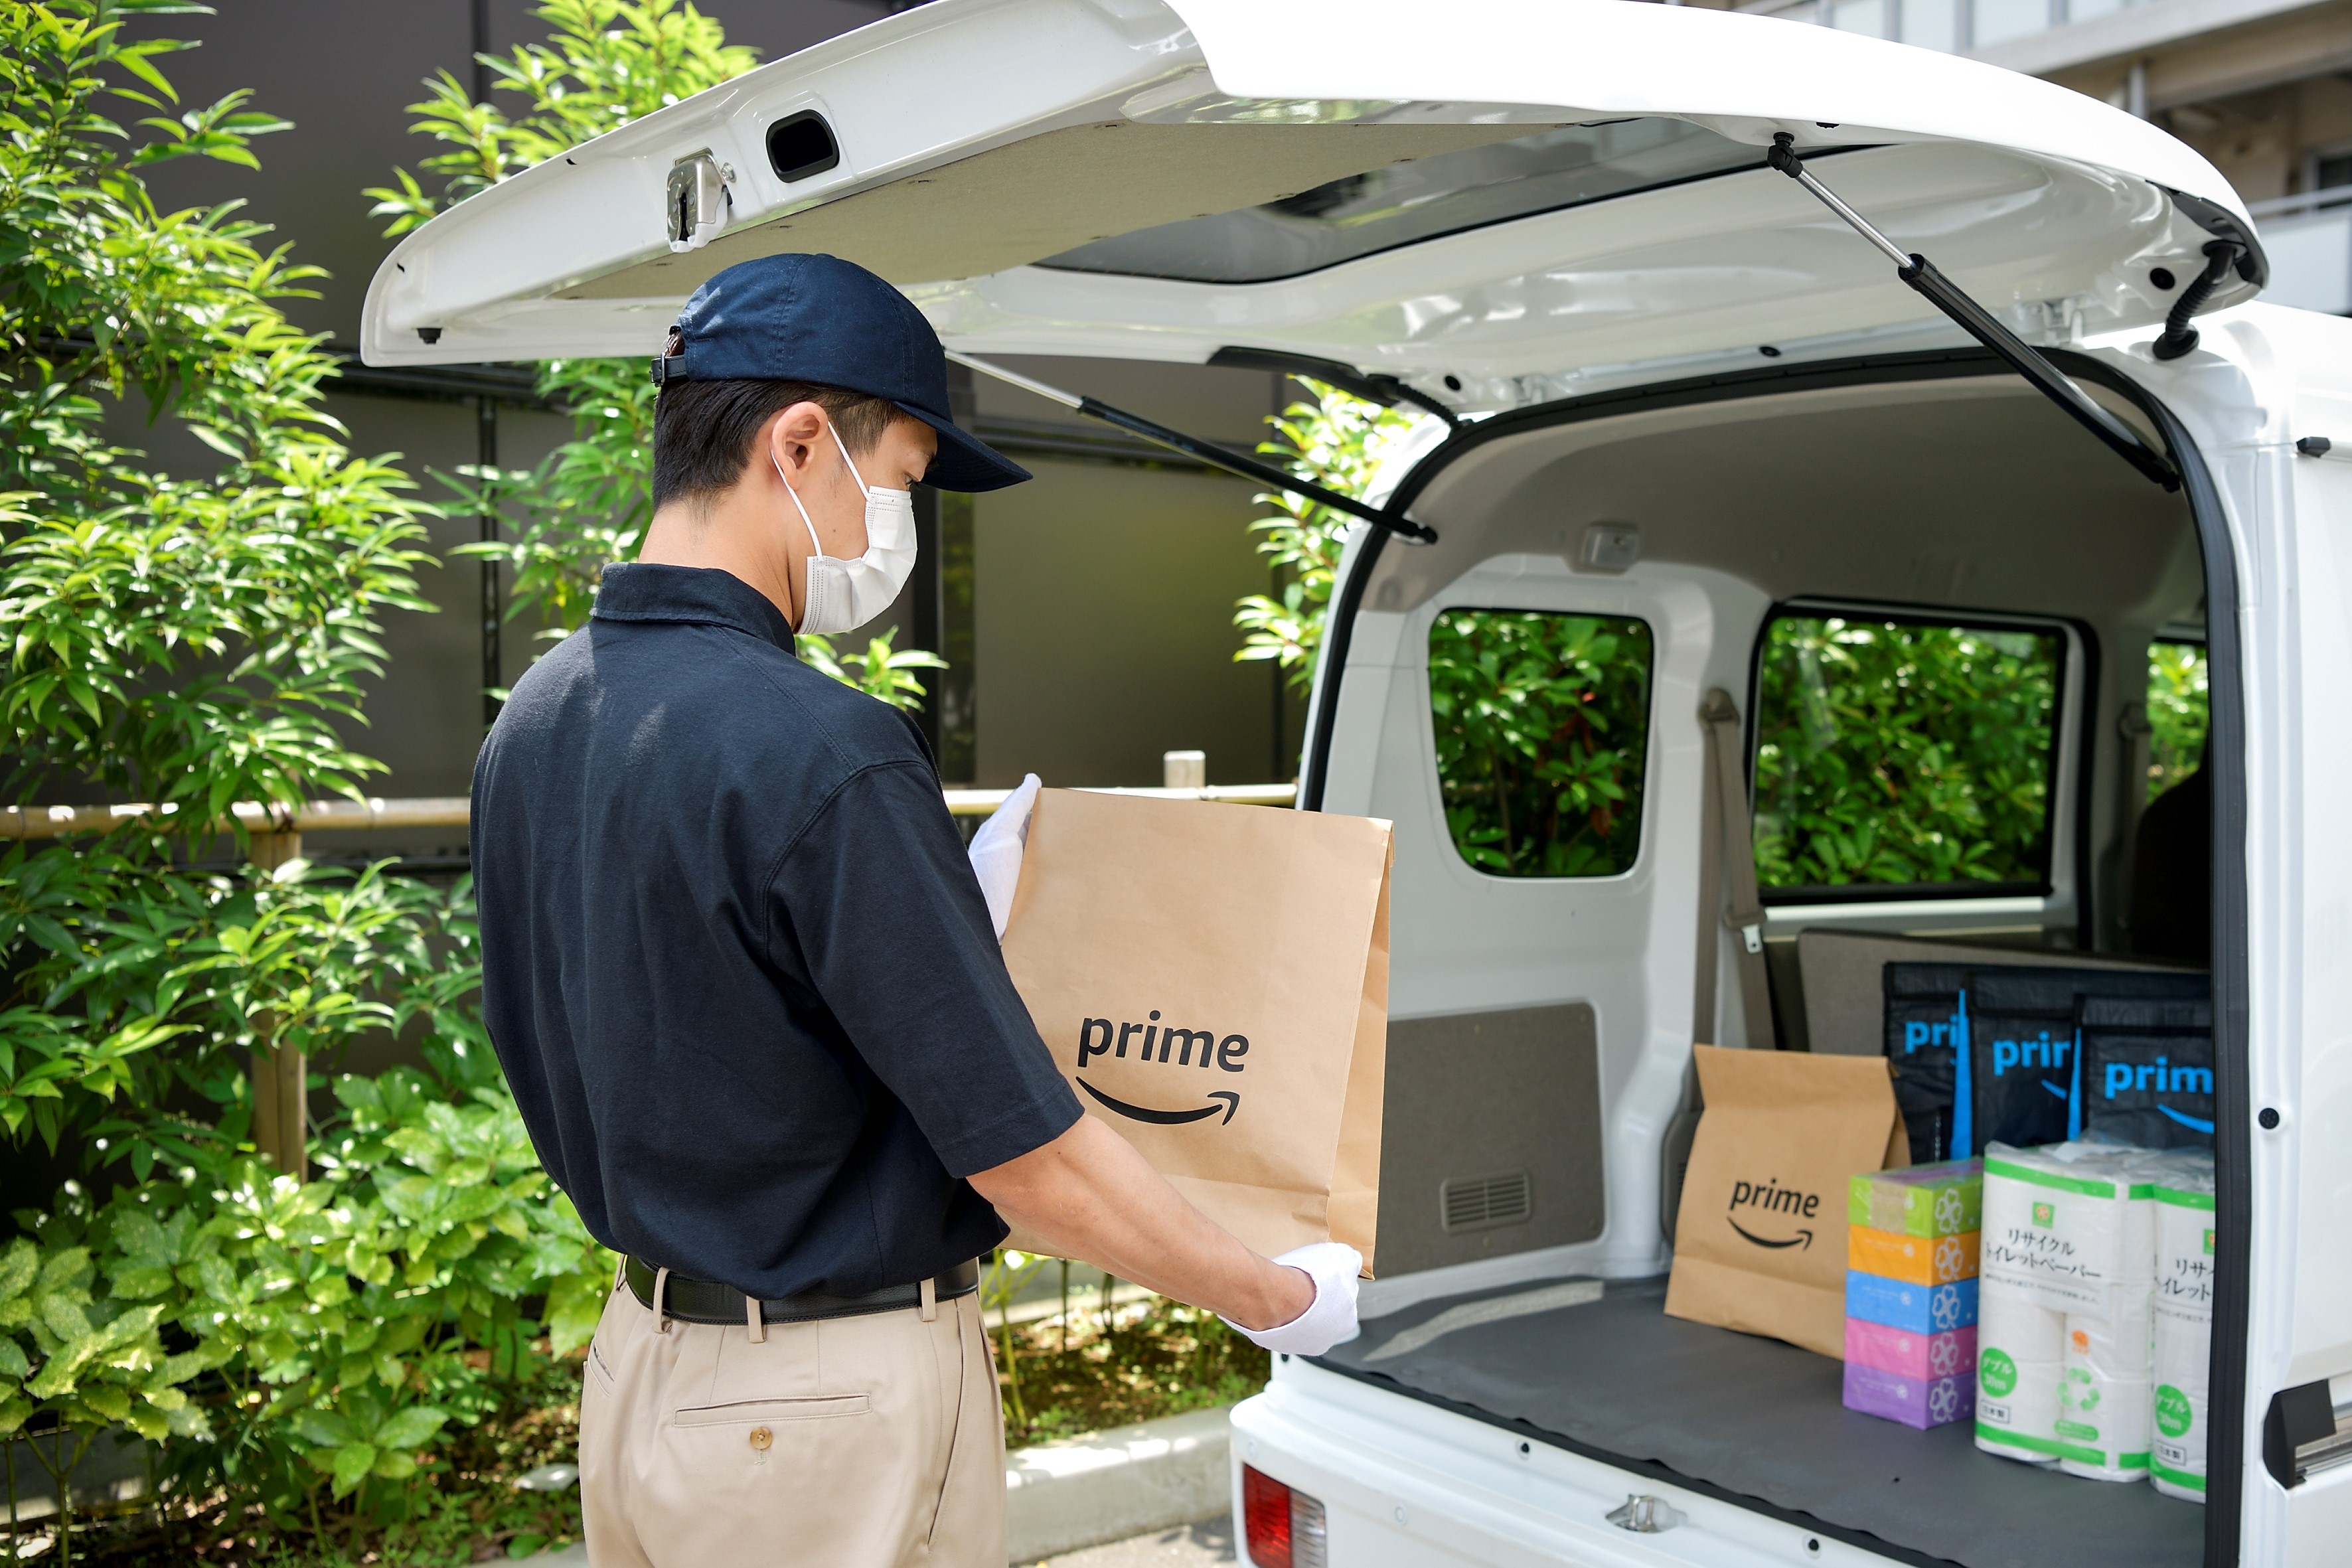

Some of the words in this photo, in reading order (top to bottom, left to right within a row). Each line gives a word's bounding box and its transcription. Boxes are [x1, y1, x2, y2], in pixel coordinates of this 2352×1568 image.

[1077, 1010, 1249, 1072] prime
[1905, 1014, 1958, 1054] pri
[1993, 1030, 2071, 1076] pri
[2105, 1056, 2213, 1099] prim
[1729, 1178, 1820, 1218] prime
[1986, 1242, 2102, 1277] トイレットペーパー
[2008, 1227, 2075, 1255] リサイクル
[2176, 1259, 2214, 1279] リサ
